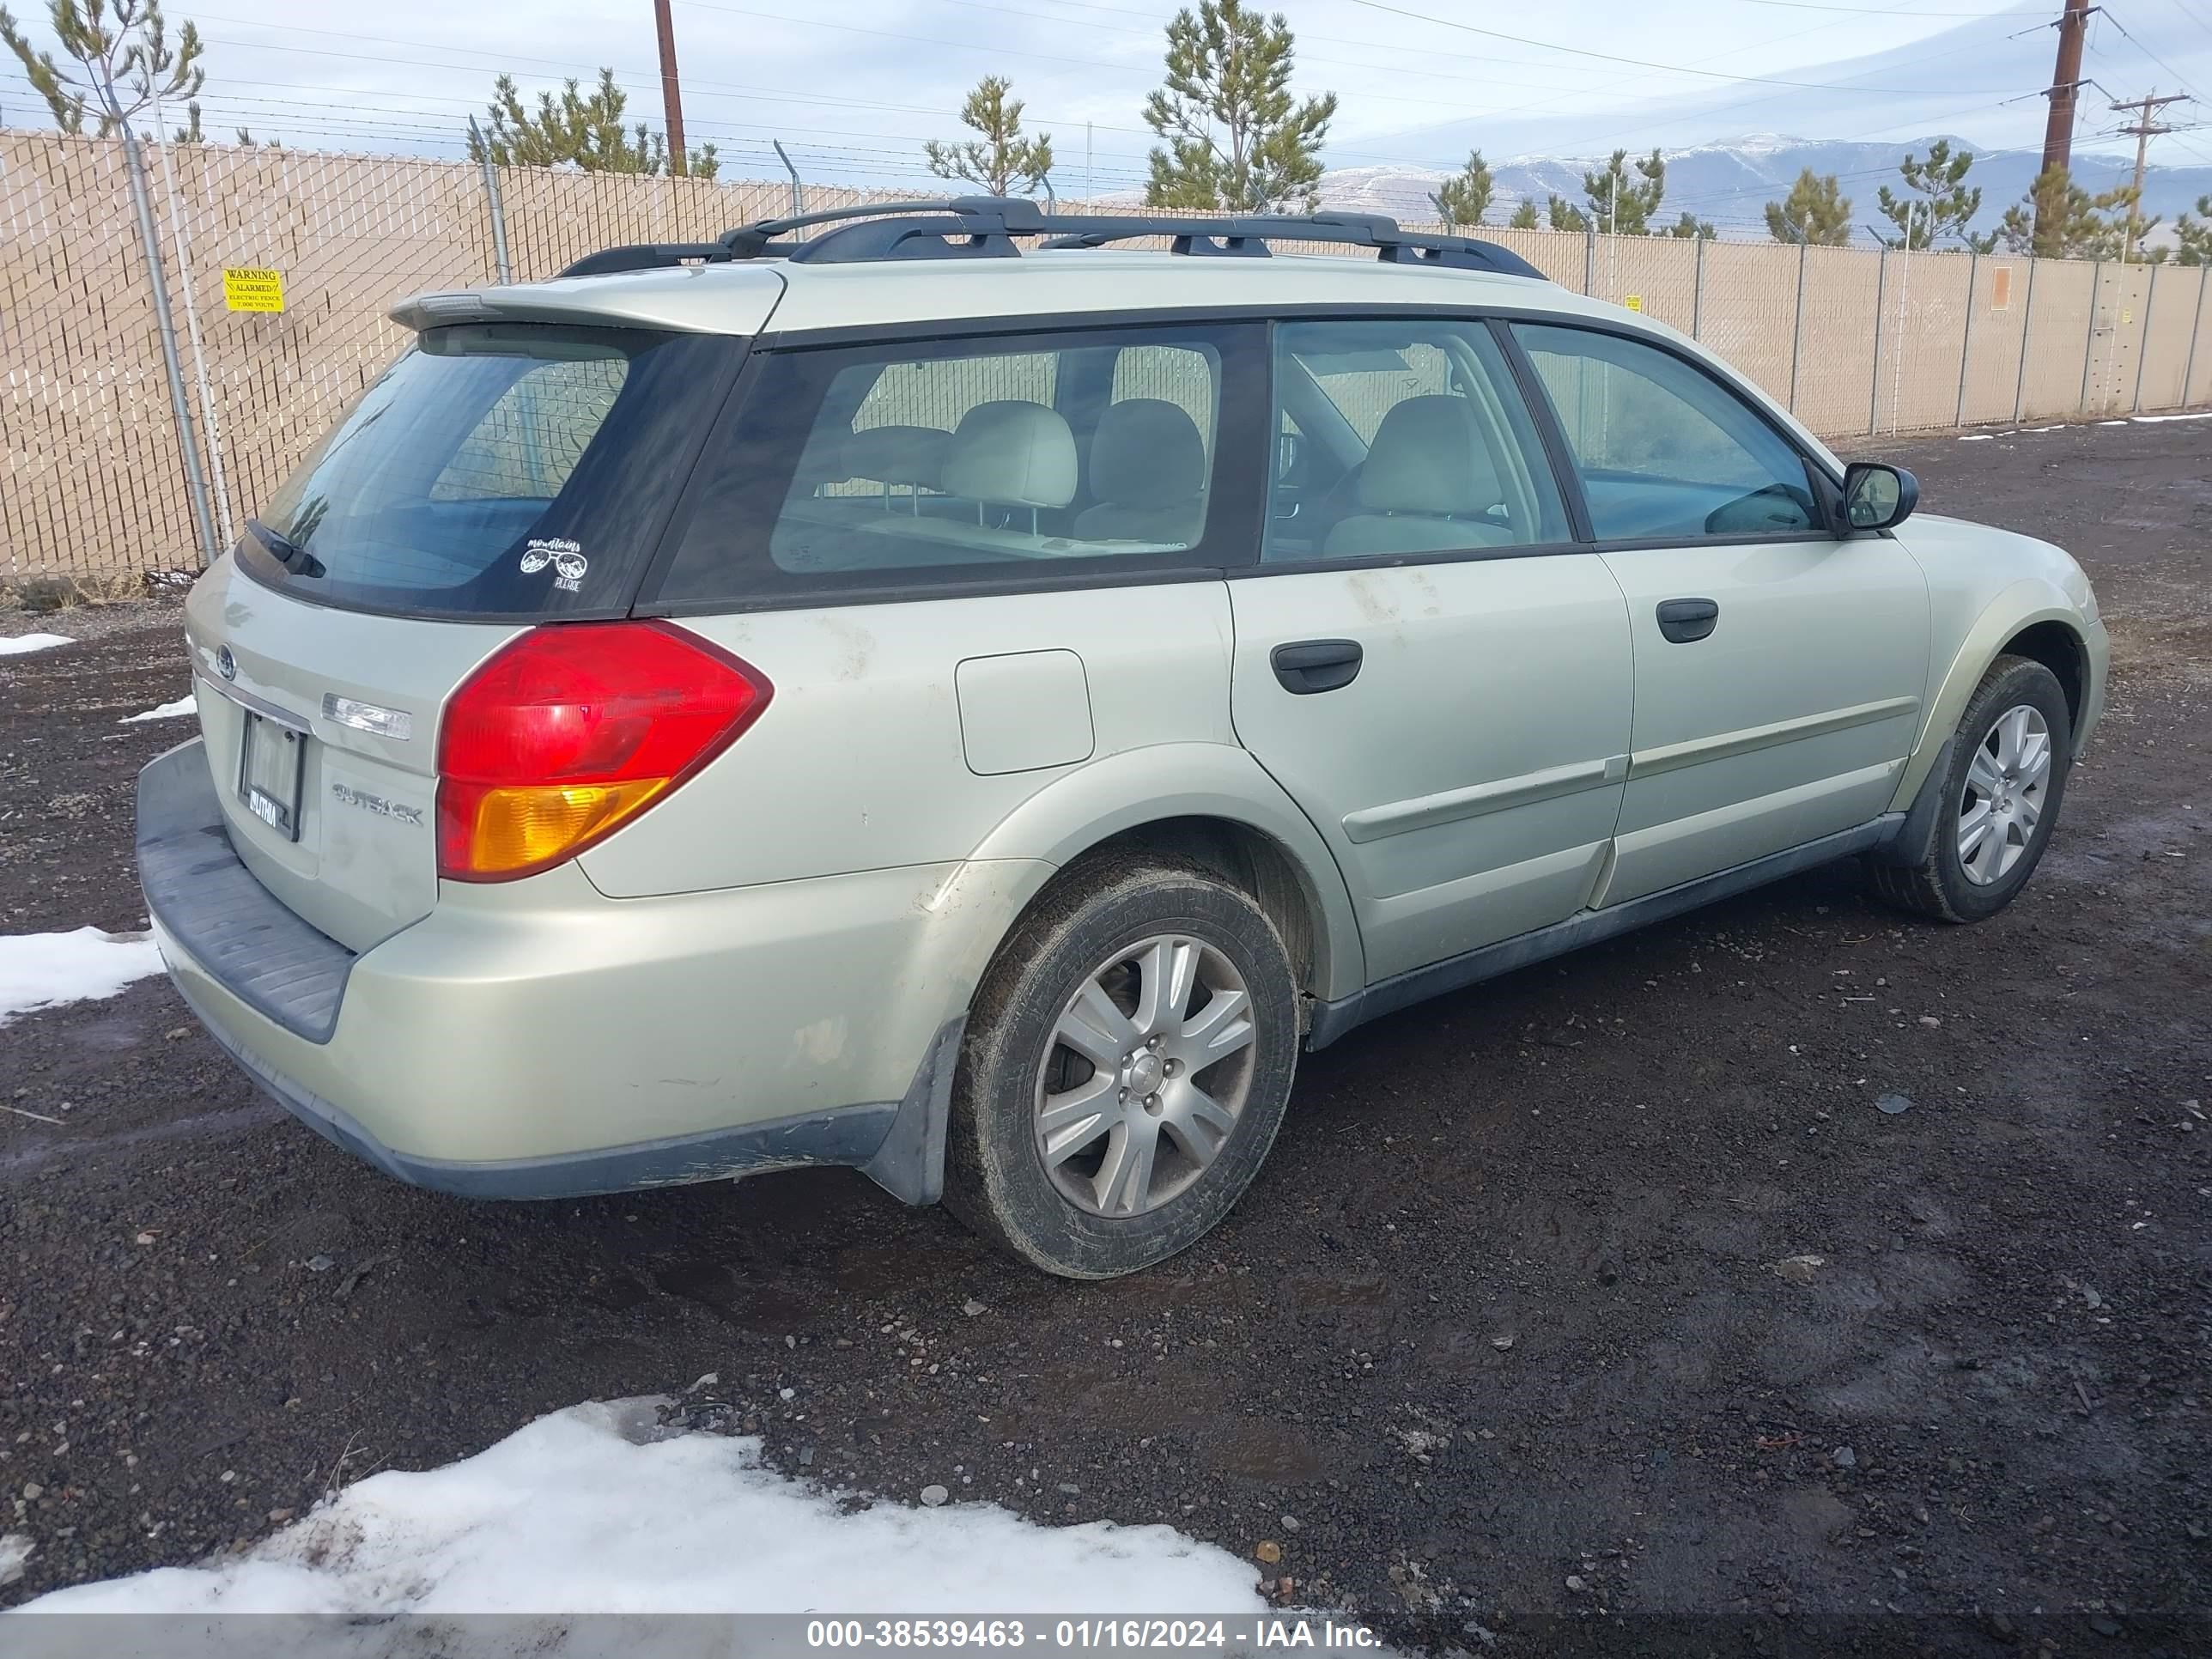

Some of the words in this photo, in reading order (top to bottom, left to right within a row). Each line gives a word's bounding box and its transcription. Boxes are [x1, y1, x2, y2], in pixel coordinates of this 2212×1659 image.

[227, 270, 276, 280] WARNING
[555, 577, 582, 591] PLEASE
[331, 782, 424, 828] OUTBACK
